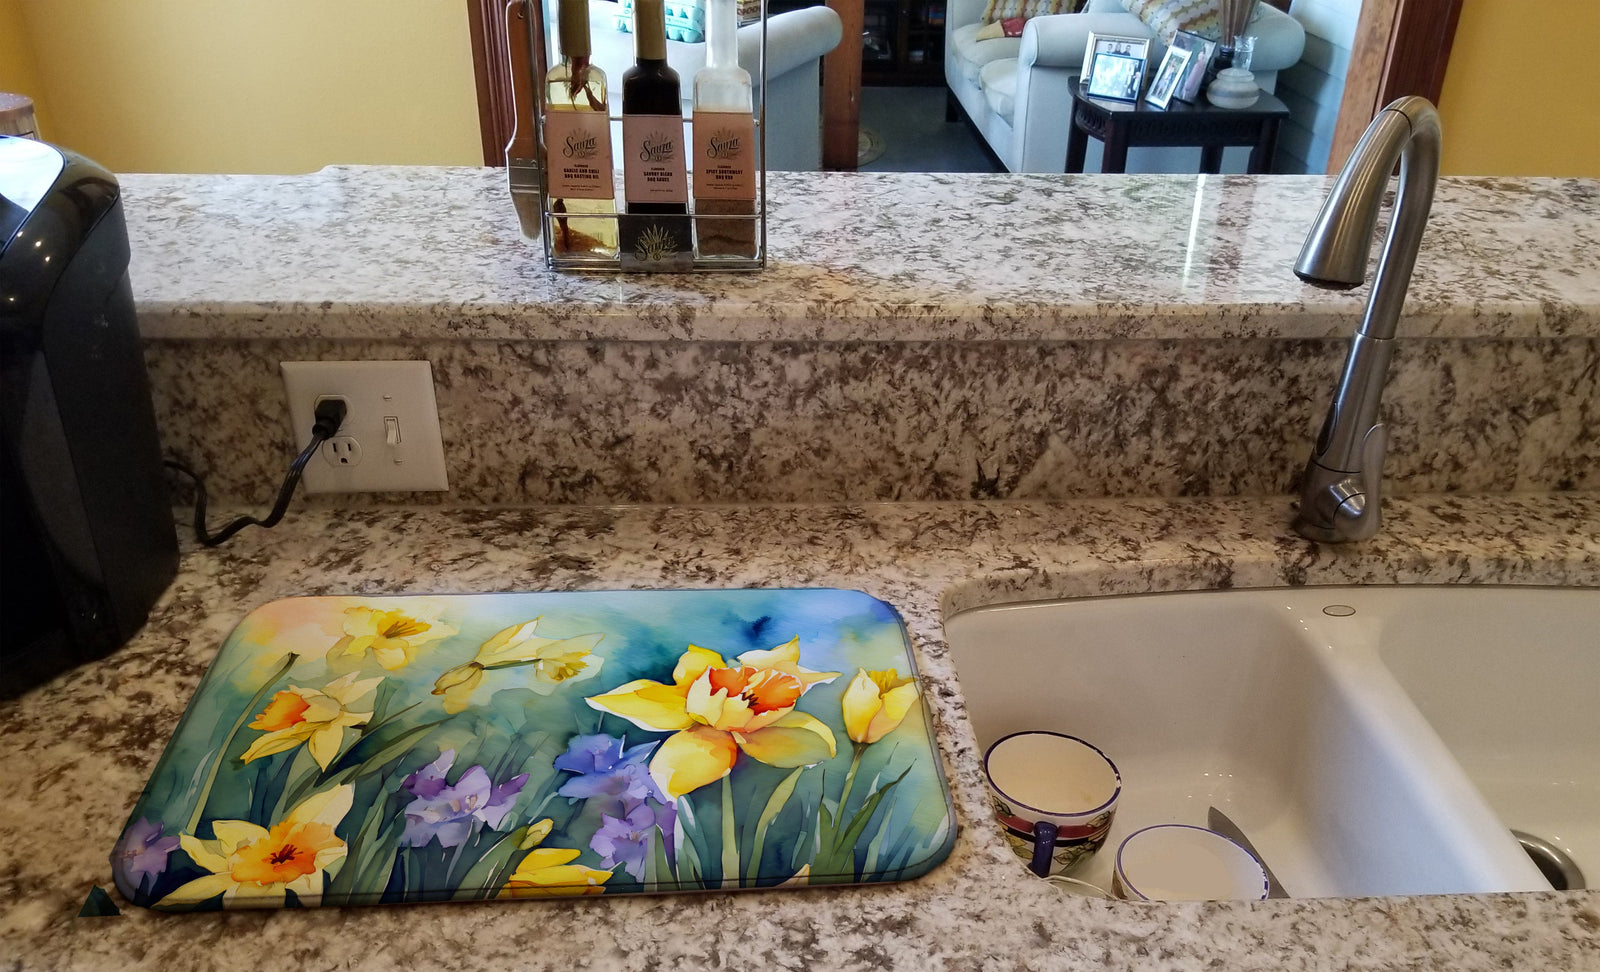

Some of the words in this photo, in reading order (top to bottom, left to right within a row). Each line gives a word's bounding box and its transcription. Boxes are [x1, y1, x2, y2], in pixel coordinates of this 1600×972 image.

[563, 136, 598, 159] Sauza
[640, 140, 674, 161] Sauza
[707, 136, 741, 159] Sauza
